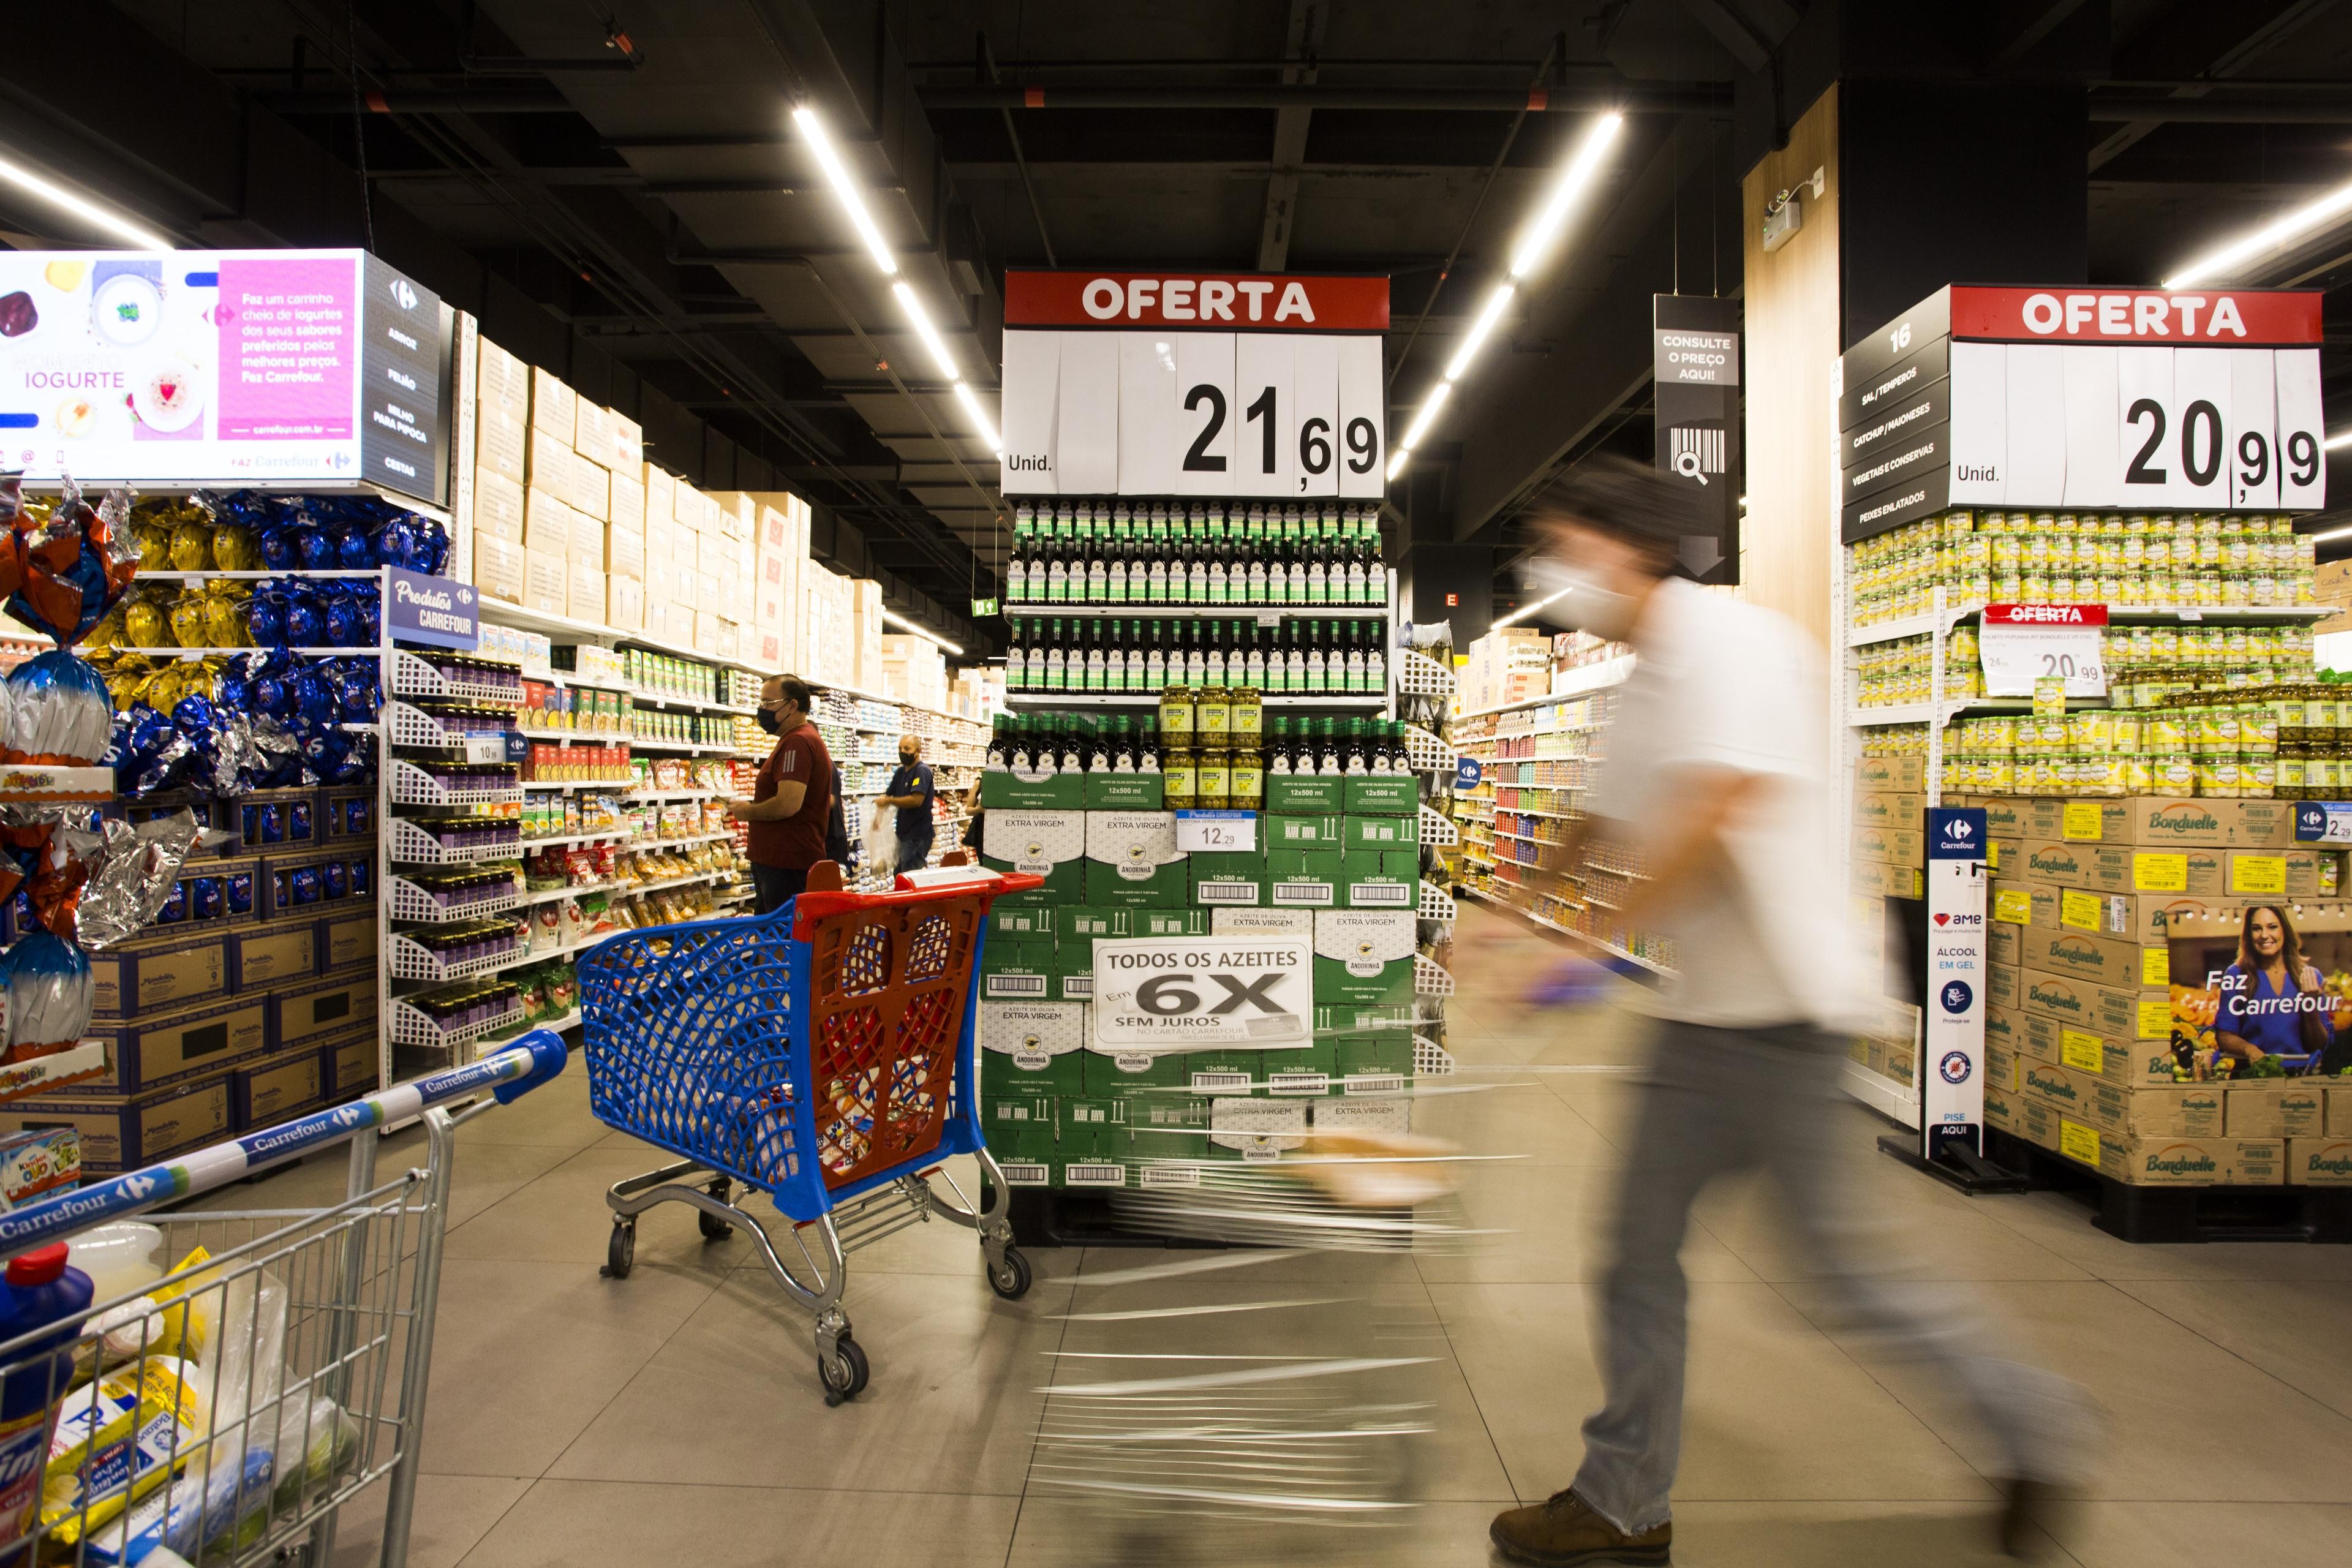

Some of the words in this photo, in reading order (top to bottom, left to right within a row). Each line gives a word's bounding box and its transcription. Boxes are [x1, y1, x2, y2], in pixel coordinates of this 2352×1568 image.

[242, 293, 263, 305] Faz
[266, 295, 284, 305] um
[287, 294, 334, 305] carrinho
[1082, 278, 1316, 323] OFERTA
[242, 309, 274, 321] cheio
[277, 310, 292, 320] de
[295, 309, 343, 322] iogurtes
[2022, 293, 2247, 337] OFERTA
[242, 325, 263, 336] dos
[266, 326, 293, 336] seus
[296, 325, 342, 336] sabores
[388, 327, 418, 351] ARROZ
[1890, 323, 1911, 353] 16
[242, 340, 301, 354] preferidos
[304, 340, 335, 353] pelos
[1662, 336, 1731, 350] CONSULTE
[242, 356, 295, 368] melhores
[1668, 352, 1679, 363] O
[1681, 353, 1725, 368] PREÇO
[26, 372, 124, 388] IOGURTE
[242, 371, 263, 383] Faz
[388, 368, 417, 391] FEIJÃO
[1679, 368, 1715, 381] AQUI!
[1861, 391, 1875, 406] SAL
[1878, 366, 1917, 396] TEMPEROS
[387, 403, 415, 424] MILHO
[253, 424, 323, 434] carrefour.com.br
[373, 410, 398, 431] PARA
[397, 421, 428, 443] PIPOCA
[1853, 424, 1885, 448] CATCHUP
[1887, 402, 1931, 432] MAIONESES
[255, 454, 319, 467] Carrefour
[385, 457, 416, 478] CESTAS
[1008, 454, 1052, 471] Unid.
[1852, 464, 1885, 486] VEGETAIS
[1890, 443, 1934, 470] CONSERVAS
[1958, 465, 2000, 483] Unid.
[1859, 506, 1882, 524] PEIXES
[1882, 490, 1926, 516] ENLATADOS
[394, 579, 452, 611] Produtos
[1447, 594, 1456, 606] E
[420, 609, 472, 635] CARREFOUR
[2010, 606, 2083, 622] OFERTA
[2149, 812, 2218, 833] Bonduelle
[2329, 820, 2351, 837] 2,29
[1202, 827, 1235, 845] 12,29
[2029, 853, 2078, 874] Bonduelle
[1107, 952, 1178, 970] TODOS
[1185, 952, 1211, 967] OS
[1218, 951, 1297, 967] AZEITES
[1937, 946, 1977, 956] ÁLCOOL
[2049, 940, 2104, 966] Bonduelle
[2206, 970, 2248, 991] Faz
[1106, 990, 1131, 1003] Em
[1136, 973, 1289, 1016] 6X
[2029, 985, 2081, 1012] Bonduelle
[2228, 992, 2342, 1016] Carrefour
[1115, 1017, 1153, 1027] SEM
[1159, 1017, 1221, 1027] JUROS
[1153, 1026, 1189, 1035] CARTÃO
[1192, 1027, 1244, 1035] CARREFOUR
[425, 1068, 481, 1093] Carrefour
[2027, 1070, 2076, 1101] Bonduelle
[2181, 1098, 2217, 1110] Bonduelle
[1943, 1113, 1966, 1121] PISE
[254, 1118, 328, 1153] Carrefour
[1942, 1126, 1967, 1136] AQUI
[2146, 1153, 2217, 1175] Bonduelle
[0, 1193, 107, 1239] Carrefour
